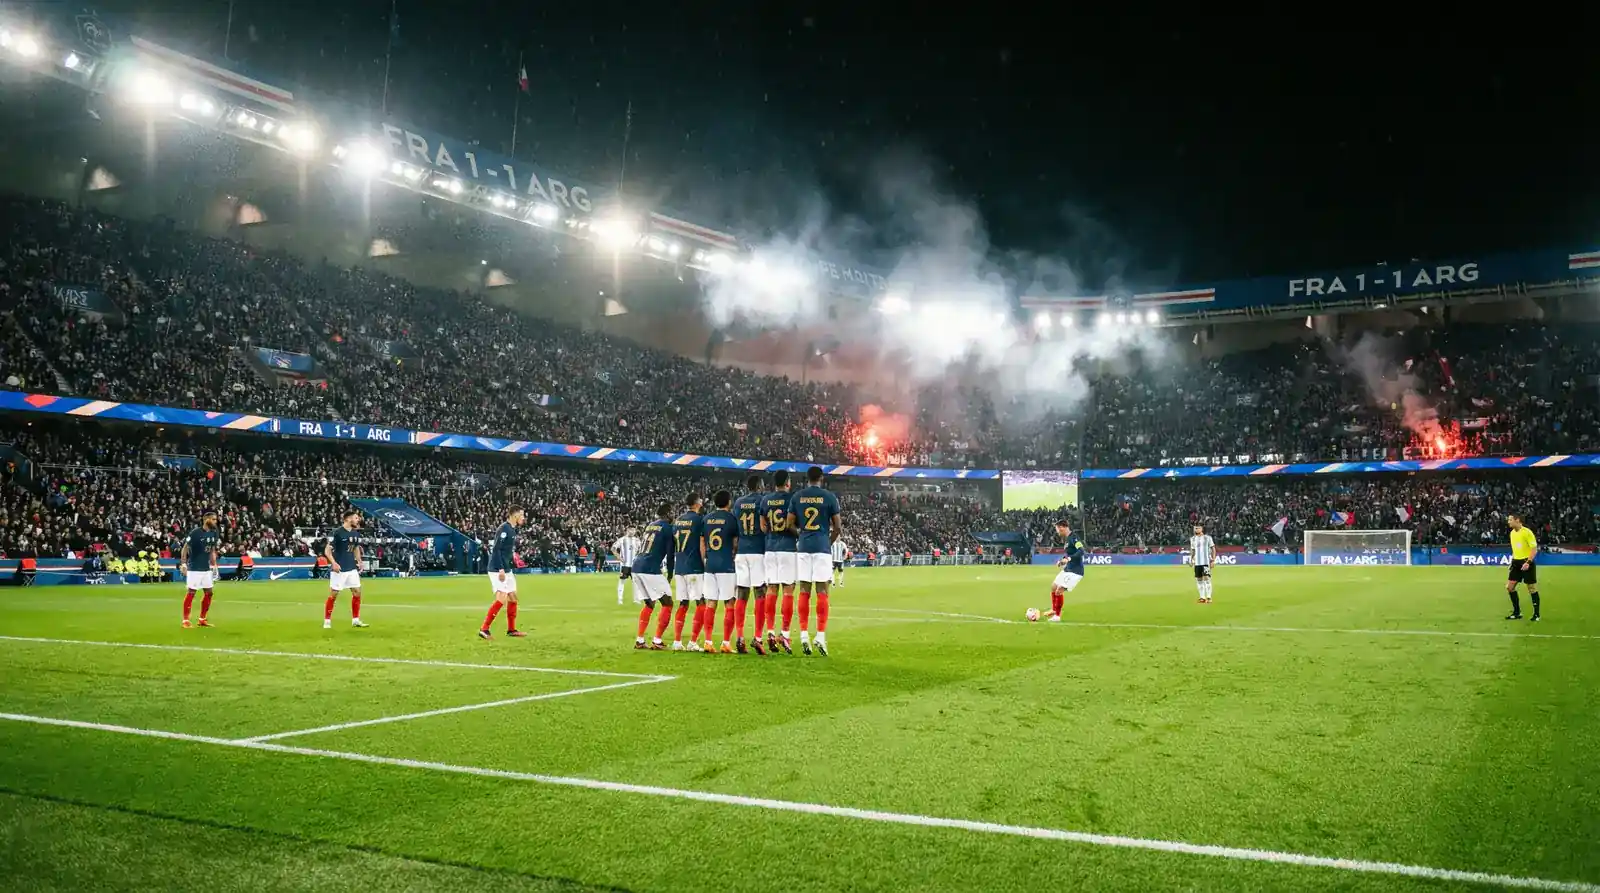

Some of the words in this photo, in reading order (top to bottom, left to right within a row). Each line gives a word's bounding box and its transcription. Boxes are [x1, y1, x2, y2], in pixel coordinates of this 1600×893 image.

[382, 122, 459, 173] FRA
[527, 172, 592, 212] ARG
[1289, 276, 1347, 297] FRA
[1412, 263, 1479, 287] ARG
[300, 422, 322, 435] FRA
[335, 424, 356, 438] 1-1
[367, 428, 391, 441] ARG
[804, 507, 821, 531] 2
[709, 528, 723, 551] 6
[1091, 555, 1112, 565] ARG
[1214, 555, 1237, 565] ARG
[1320, 555, 1342, 565] FRA
[1353, 555, 1378, 565] ARG
[1461, 555, 1485, 565] FRA
